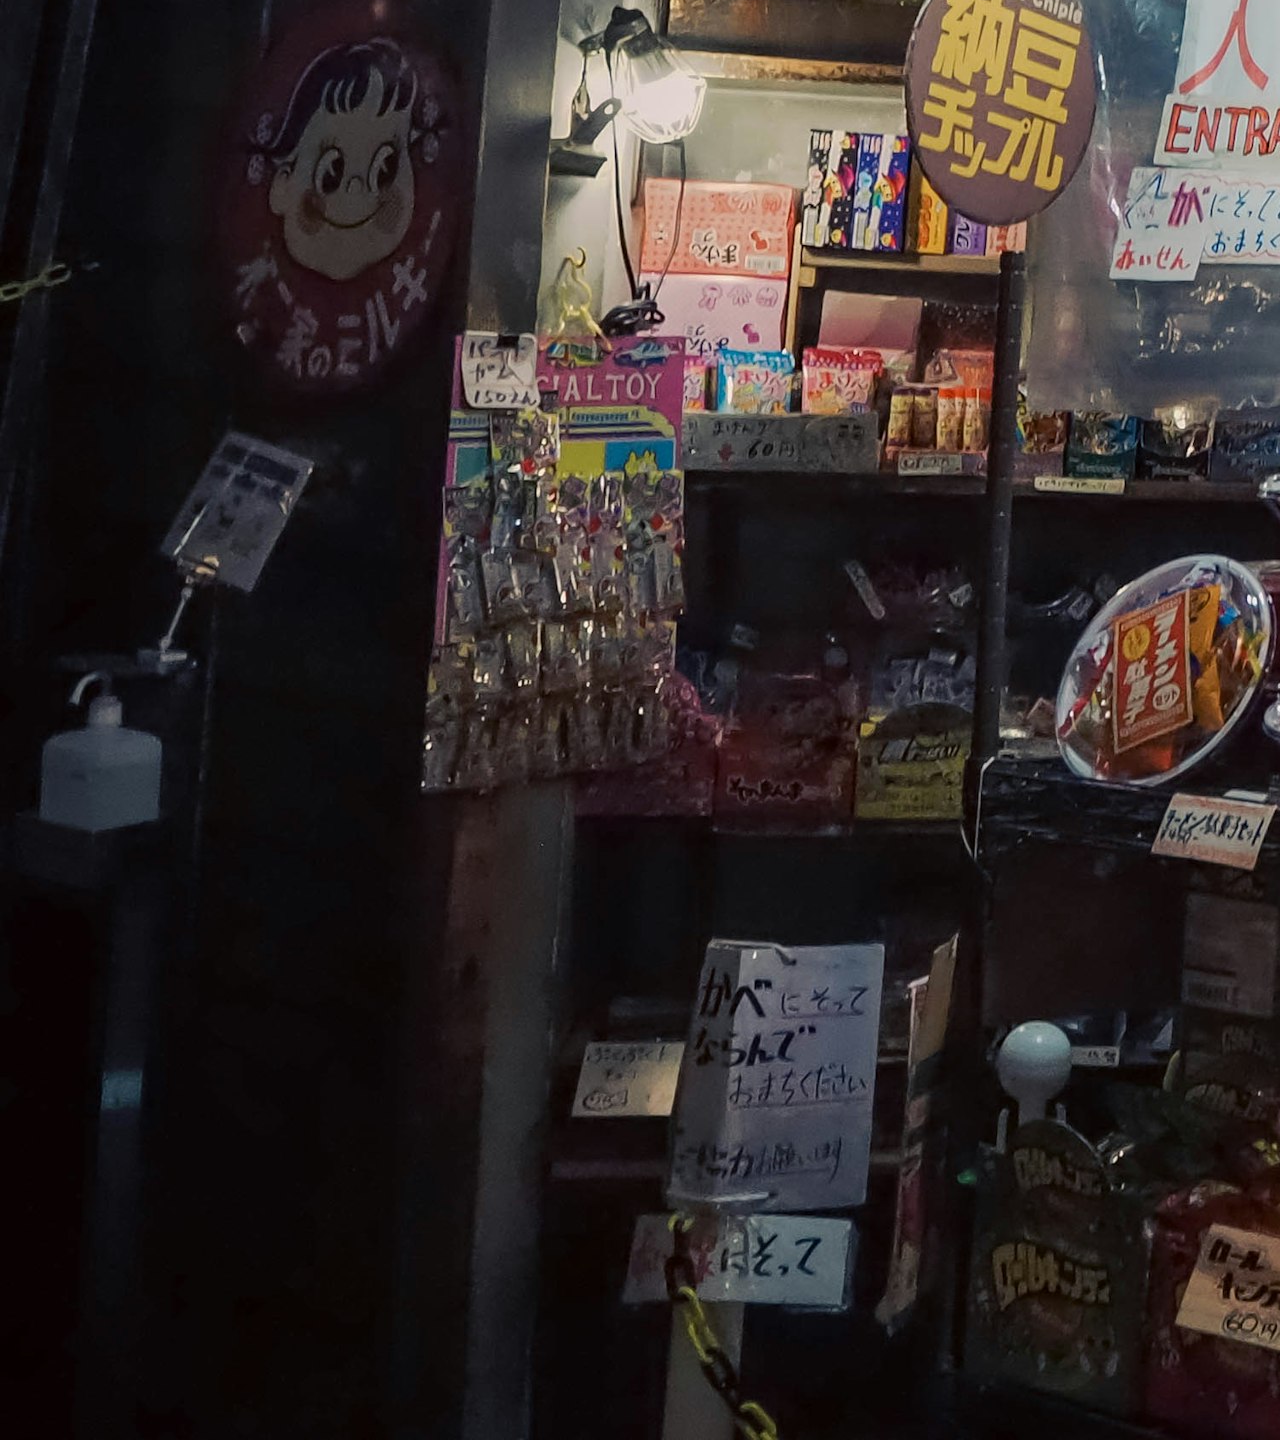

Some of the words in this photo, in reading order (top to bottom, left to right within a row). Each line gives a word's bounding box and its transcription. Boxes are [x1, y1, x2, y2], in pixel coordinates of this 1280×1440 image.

[919, 82, 1064, 192] チップル
[605, 372, 663, 402] TOY
